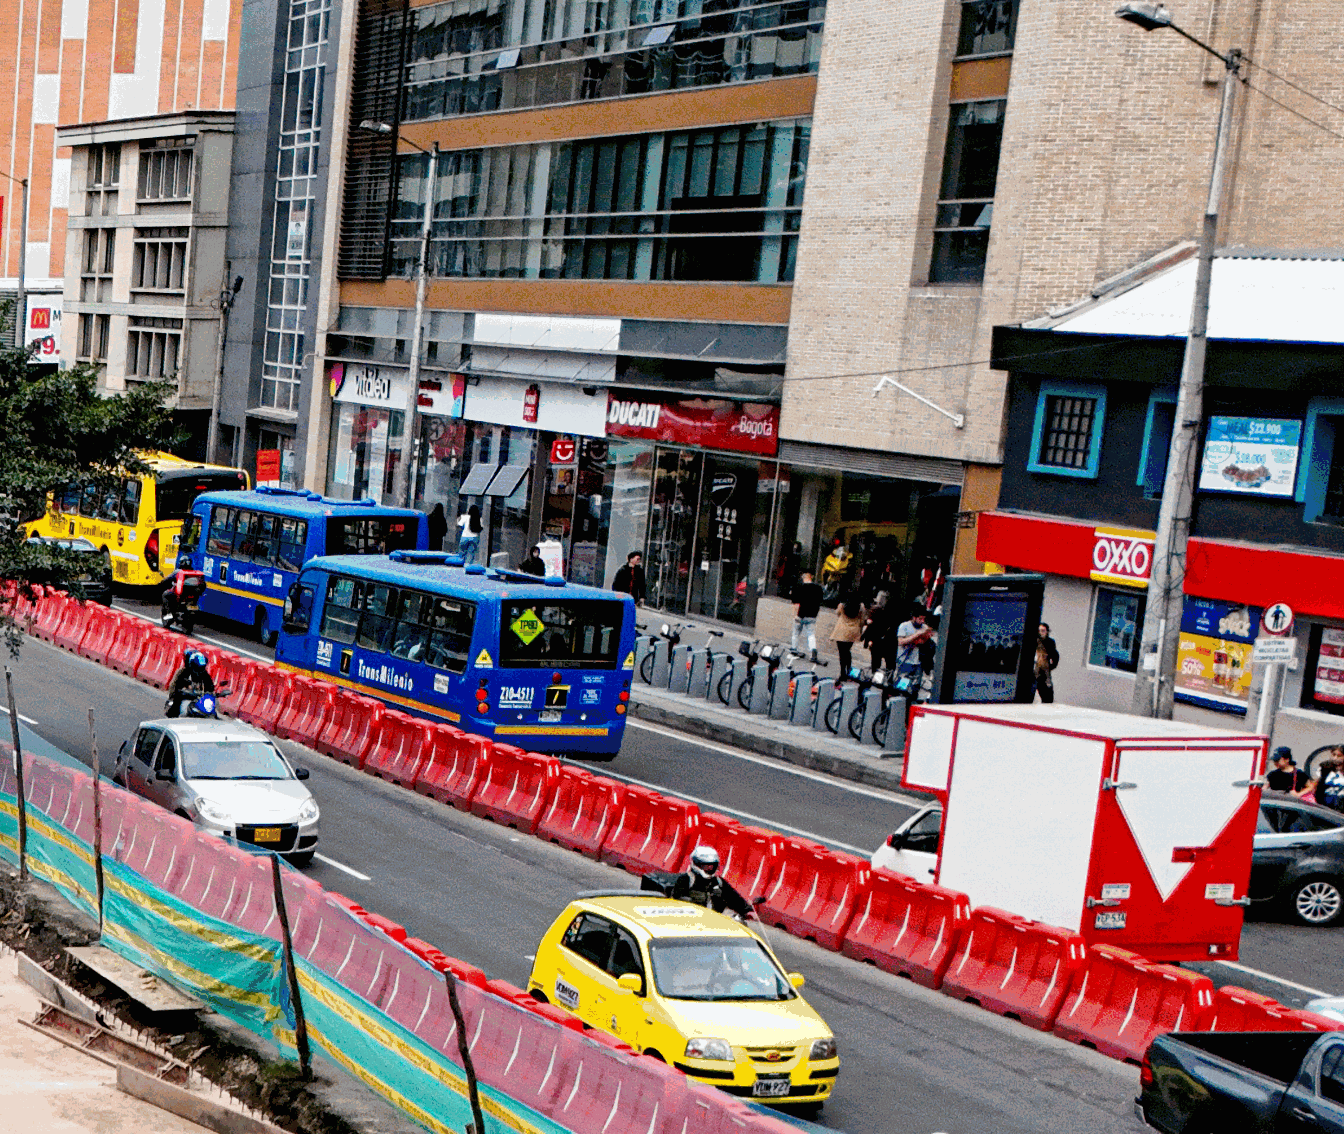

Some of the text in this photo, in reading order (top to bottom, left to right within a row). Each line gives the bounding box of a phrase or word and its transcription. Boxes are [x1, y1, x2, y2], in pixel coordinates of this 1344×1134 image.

[609, 400, 661, 428] DUCATI
[739, 415, 773, 438] Bogotá
[1093, 539, 1150, 575] OXXO
[358, 658, 414, 692] TransMilenio
[499, 686, 535, 701] Z10-4511
